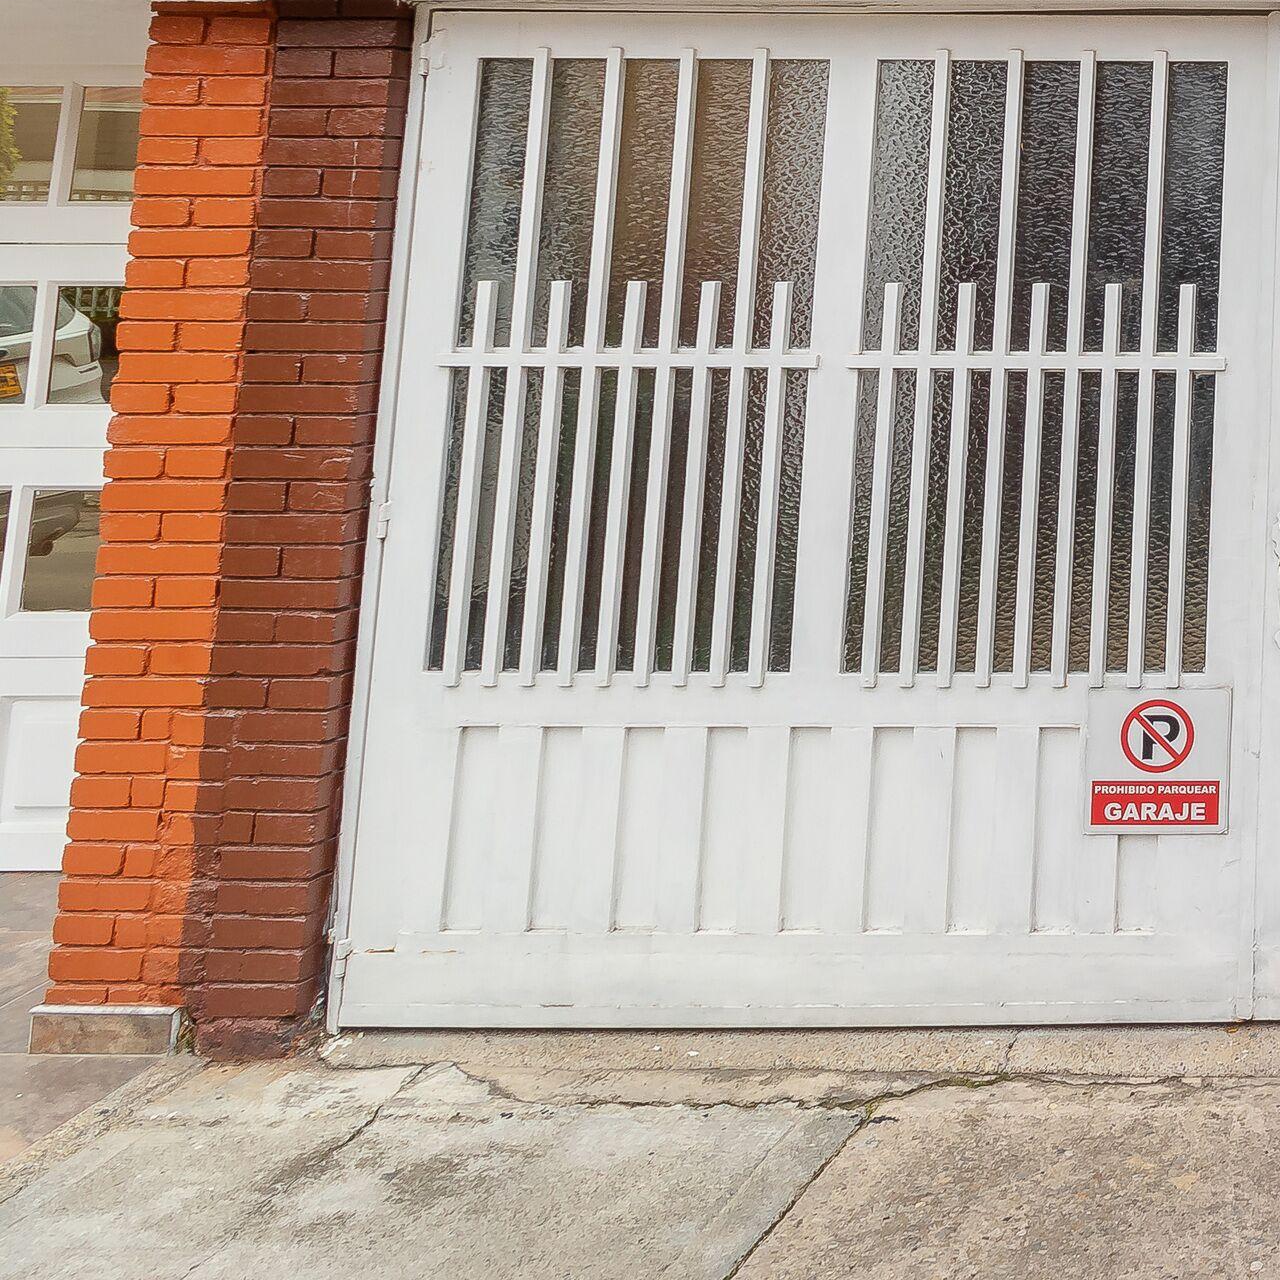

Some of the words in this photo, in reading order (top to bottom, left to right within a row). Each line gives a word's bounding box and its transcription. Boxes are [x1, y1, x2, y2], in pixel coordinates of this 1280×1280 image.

[1094, 785, 1155, 795] PROHIBIDO
[1157, 785, 1217, 795] PARQUEAR
[1104, 802, 1206, 821] GARAJE
